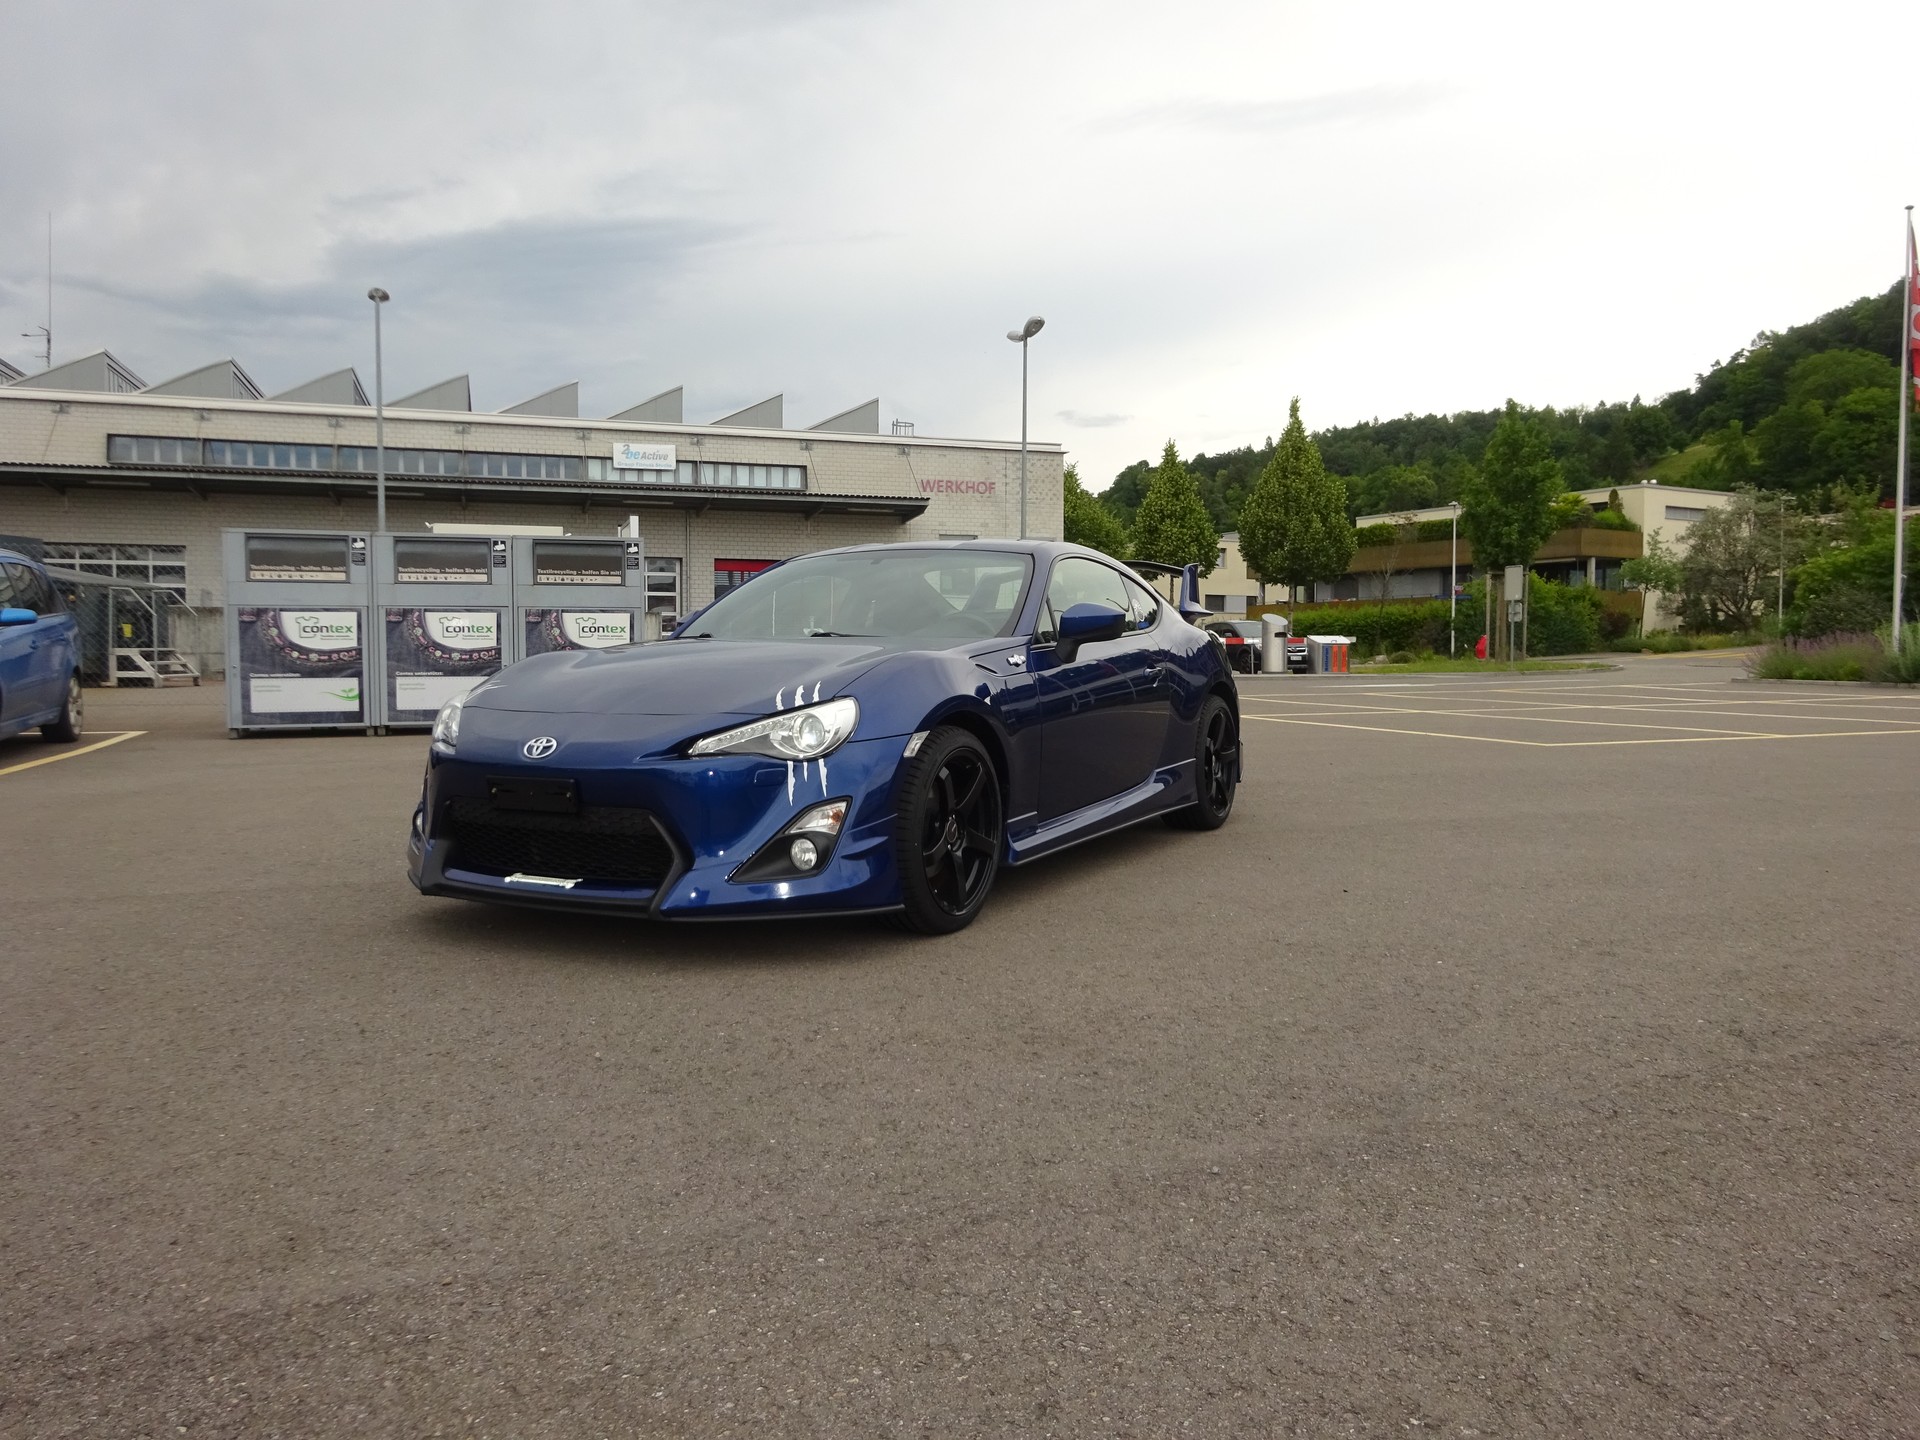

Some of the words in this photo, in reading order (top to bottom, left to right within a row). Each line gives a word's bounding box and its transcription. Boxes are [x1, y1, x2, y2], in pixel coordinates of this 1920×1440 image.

[641, 450, 669, 461] Active
[920, 479, 997, 495] WERKHOF
[302, 623, 353, 633] contex
[445, 624, 494, 634] contex
[581, 624, 627, 634] contex
